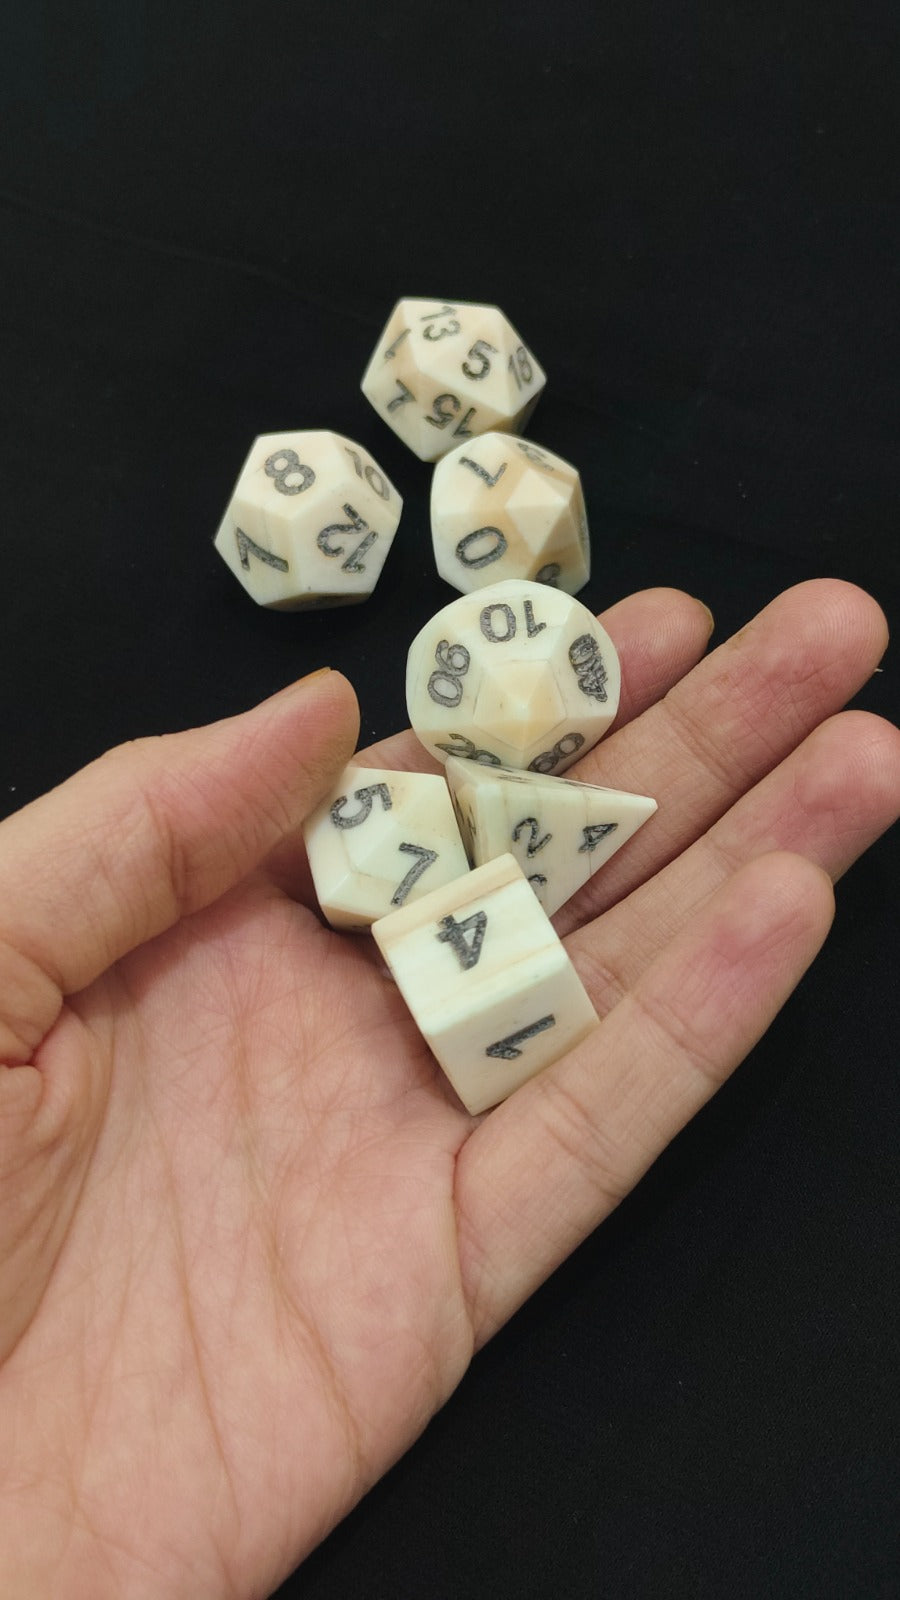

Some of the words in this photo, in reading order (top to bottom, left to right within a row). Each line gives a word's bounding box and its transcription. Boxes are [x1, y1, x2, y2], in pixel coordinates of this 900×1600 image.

[420, 305, 461, 342] 13
[461, 339, 498, 381] 5
[508, 346, 533, 392] 18
[424, 393, 477, 439] 15
[264, 449, 316, 496] 8
[344, 447, 390, 502] 10
[316, 502, 379, 574] 12
[455, 526, 508, 569] 0
[479, 600, 547, 643] 10
[330, 782, 393, 830] 5
[512, 817, 553, 859] 2
[578, 823, 619, 854] 4
[390, 842, 440, 906] 7
[435, 910, 488, 971] 4
[485, 1013, 556, 1060] 1
